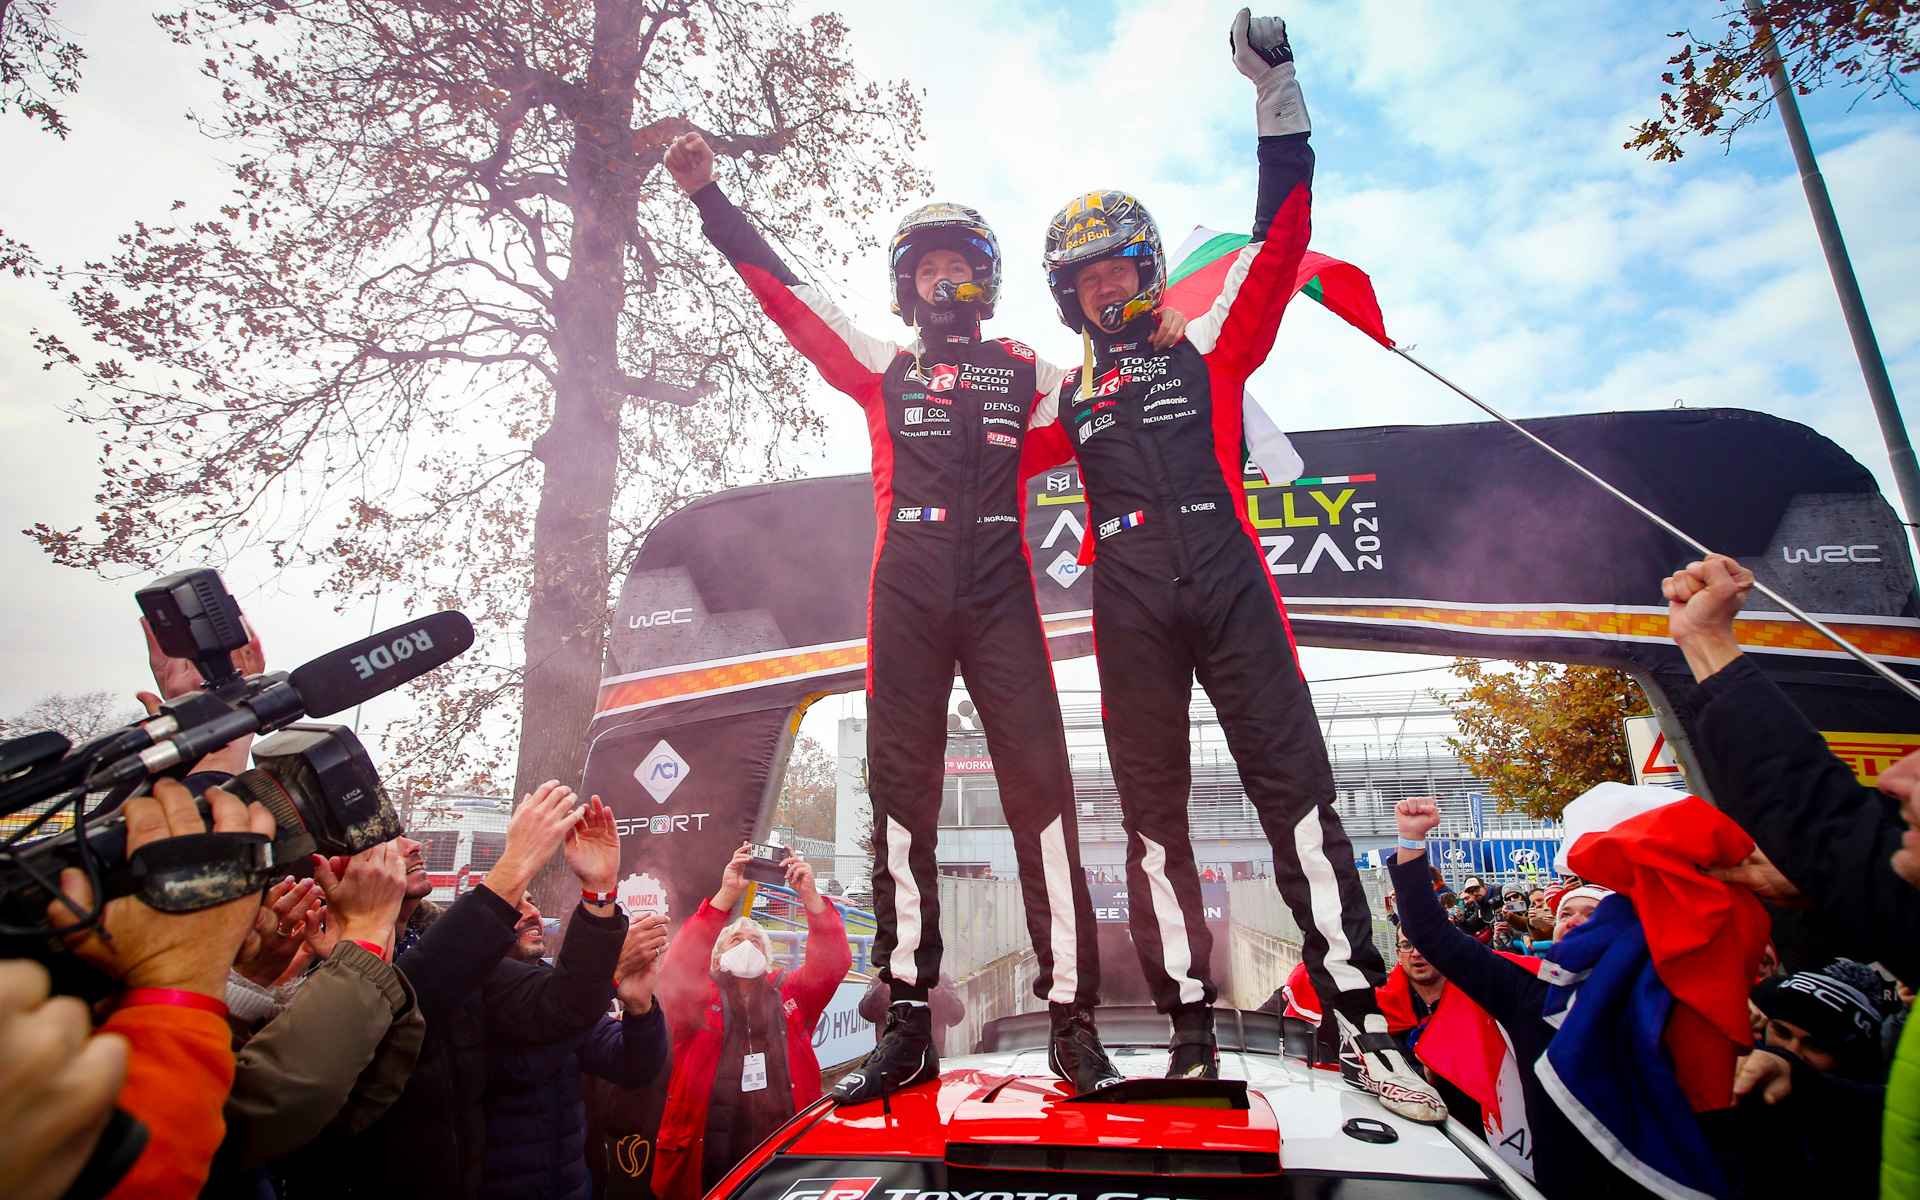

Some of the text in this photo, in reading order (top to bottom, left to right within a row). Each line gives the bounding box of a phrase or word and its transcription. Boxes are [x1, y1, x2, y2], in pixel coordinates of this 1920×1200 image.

[1066, 228, 1111, 251] Red Bull
[1011, 346, 1034, 358] OMP
[961, 362, 1015, 377] TOYOTA
[960, 372, 1010, 385] GAZOO
[958, 380, 1009, 394] Racing
[902, 393, 953, 406] DMG MORI
[1143, 395, 1189, 412] Panasonic
[983, 402, 1021, 414] DENSO
[982, 416, 1020, 429] Panasonic
[1094, 412, 1113, 428] CCI
[1142, 408, 1198, 425] RICHARD MILLE
[899, 429, 952, 438] RICHARD MILLE
[1092, 420, 1117, 434] CORPORATION
[896, 506, 923, 522] OMP
[1180, 502, 1217, 514] S. OGIER
[1246, 489, 1357, 530] LLY
[976, 514, 1019, 524] J. INGRASSIA
[1099, 517, 1122, 540] OMP
[1351, 501, 1384, 571] 2021
[1782, 544, 1882, 564] WRC
[1057, 563, 1080, 575] ACI
[629, 607, 694, 629] WRC
[350, 629, 434, 680] RØDE
[650, 761, 679, 781] ACI
[956, 760, 994, 770] WORKW
[342, 788, 362, 801] LEICA
[626, 893, 659, 907] MONZA
[1093, 907, 1121, 919] EE
